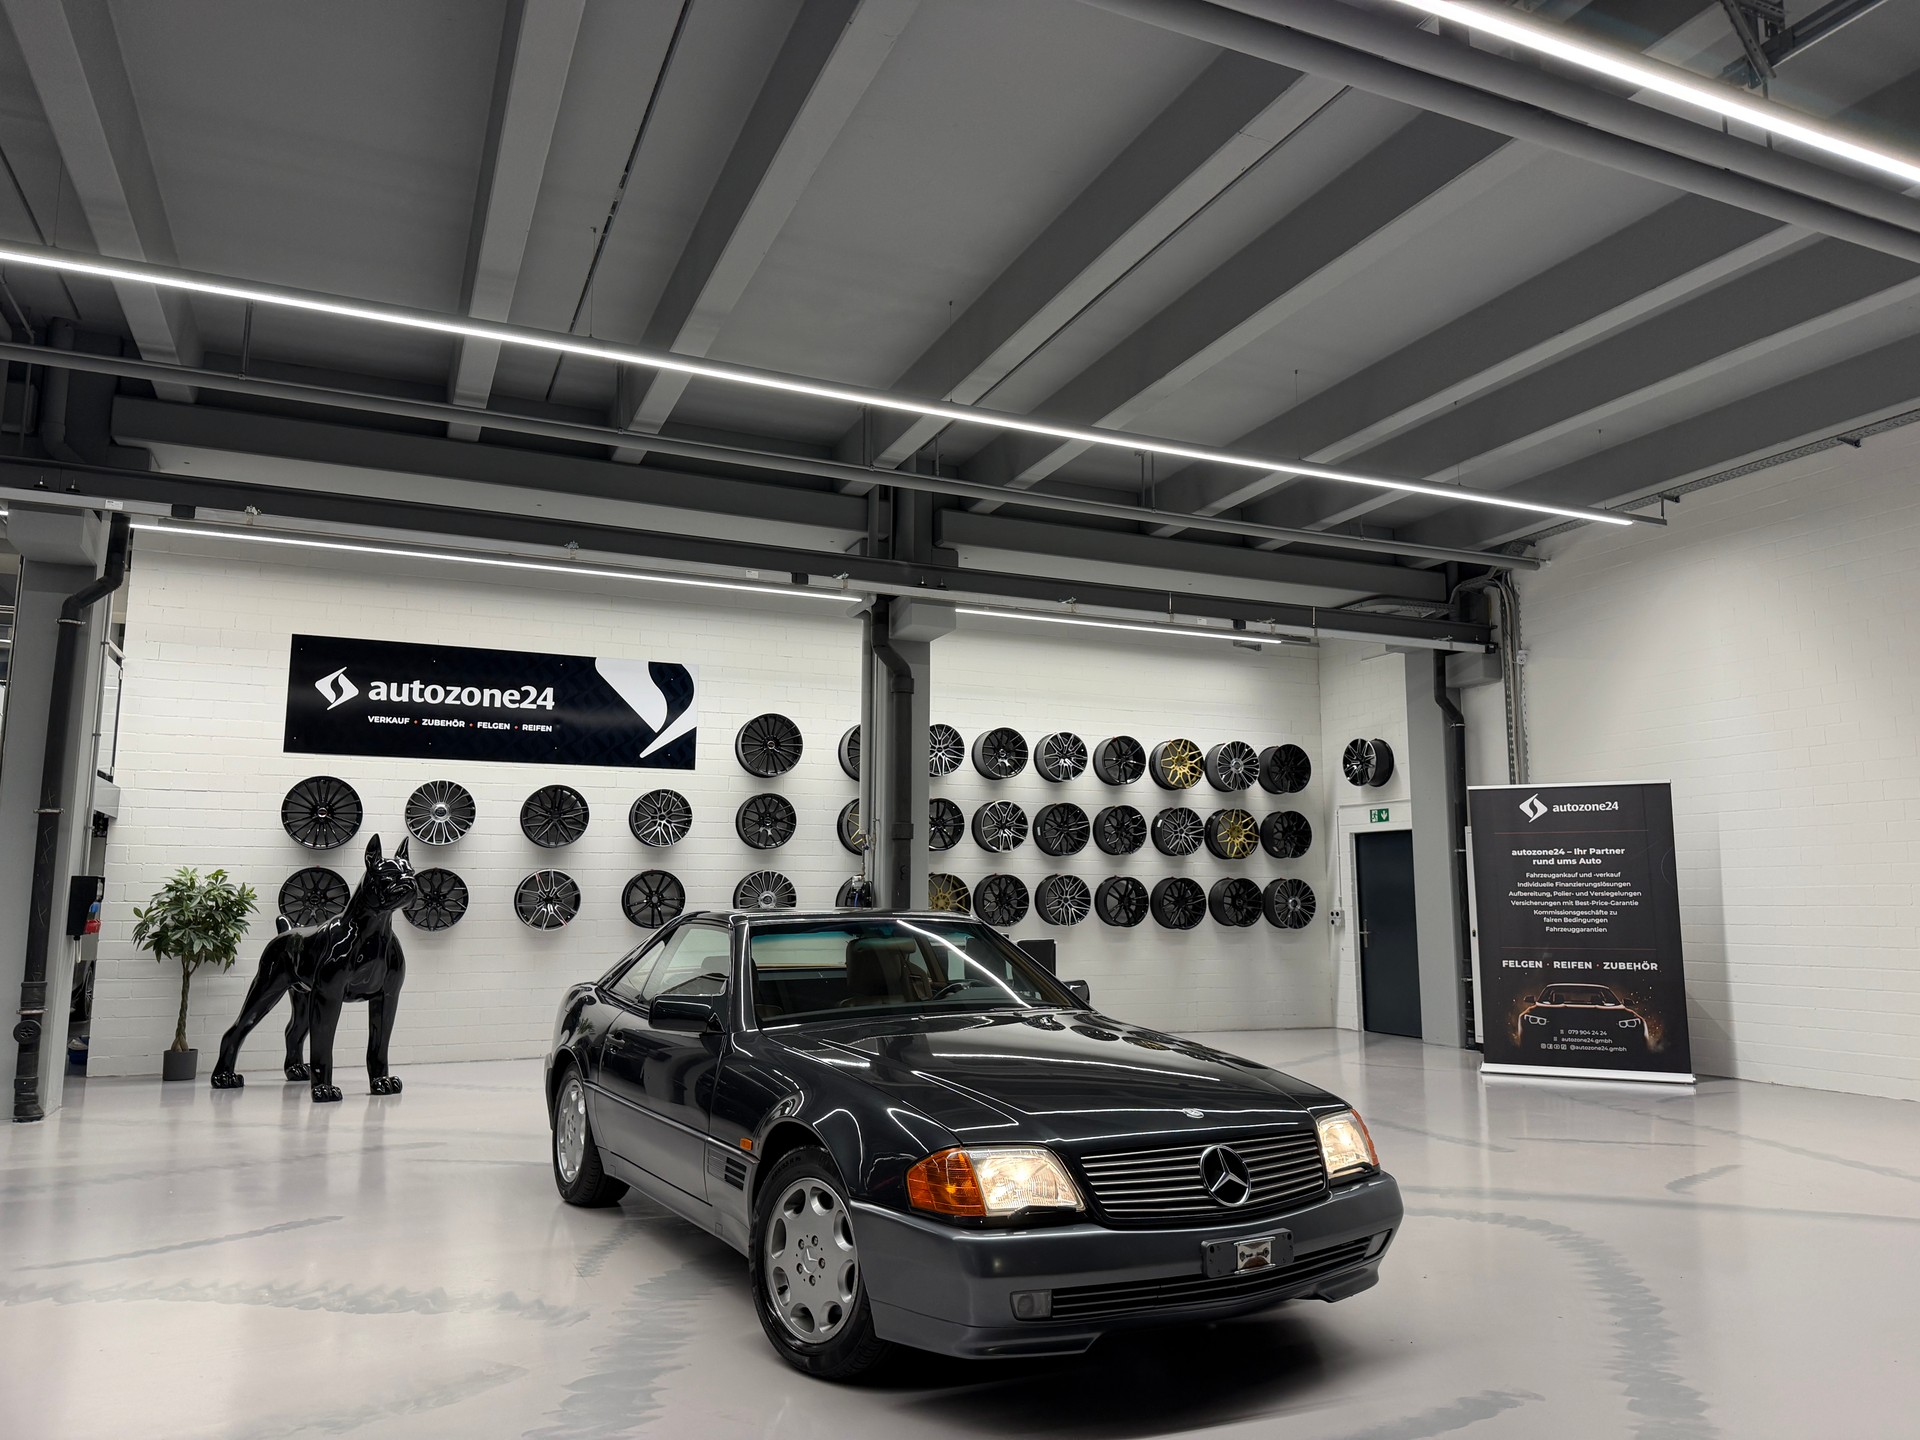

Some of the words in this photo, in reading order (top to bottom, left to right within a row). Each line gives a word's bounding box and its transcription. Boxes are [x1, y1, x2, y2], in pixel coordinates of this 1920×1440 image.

[368, 680, 555, 710] autozone24
[367, 715, 410, 725] VERKAUF
[421, 718, 465, 728] ZUBEHÖR
[477, 721, 511, 731] FELGEN
[522, 723, 553, 732] REIFEN
[1552, 801, 1619, 813] autozone24
[1511, 848, 1566, 856] autozone24
[1589, 847, 1625, 855] Partner
[1532, 857, 1555, 865] rund
[1579, 857, 1602, 865] Auto
[1525, 872, 1578, 880] Fahrzeugankauf
[1589, 890, 1642, 898] Versiegelungen
[1563, 916, 1608, 924] Bedingungen
[1502, 960, 1543, 969] FELGEN
[1553, 961, 1593, 970] REIFEN
[1603, 960, 1659, 971] ZUBEHÖR
